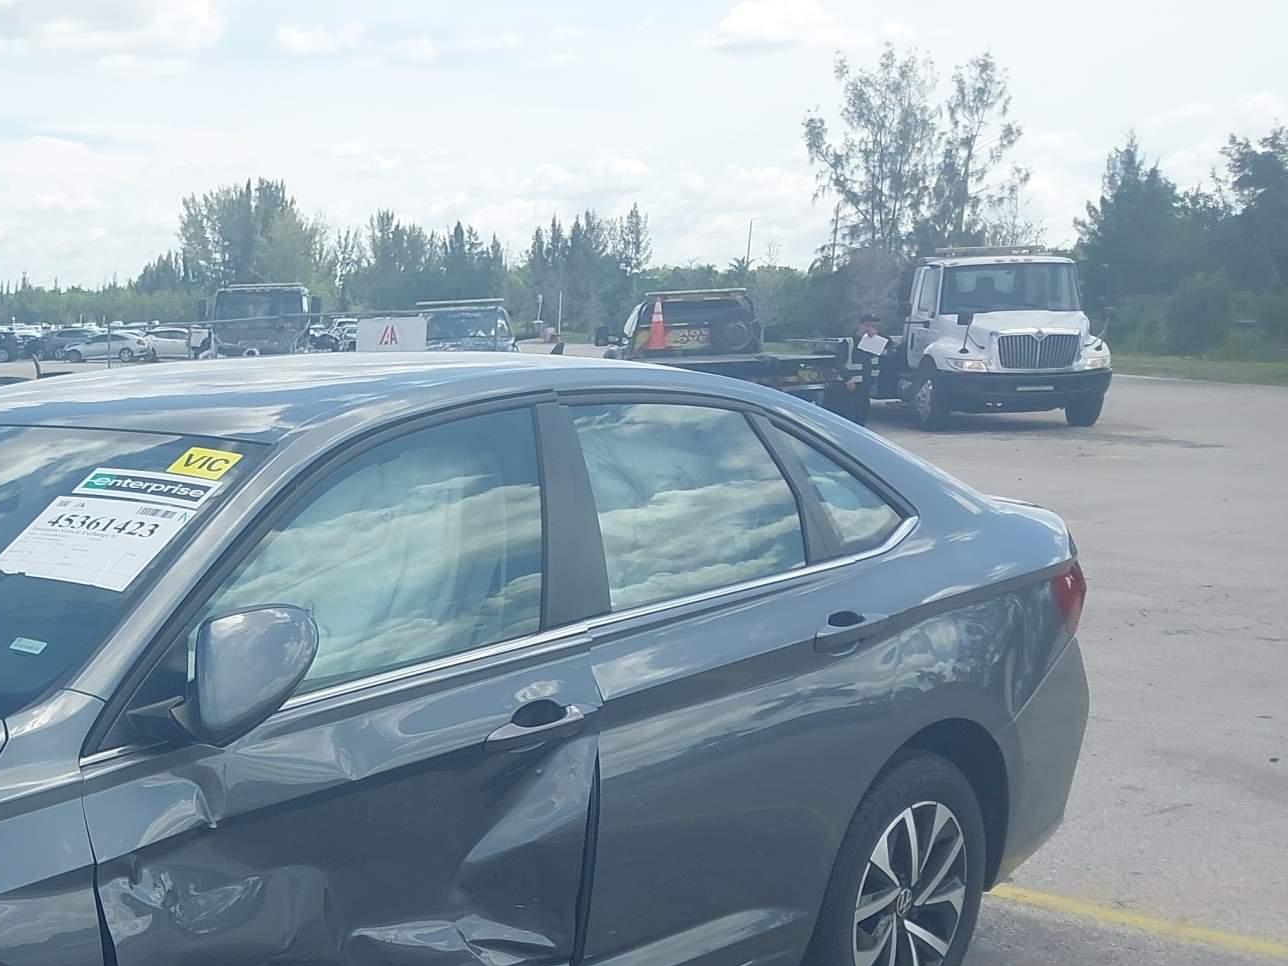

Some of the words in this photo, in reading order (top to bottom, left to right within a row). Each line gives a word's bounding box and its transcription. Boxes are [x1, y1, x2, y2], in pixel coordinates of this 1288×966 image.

[183, 453, 230, 472] VIC
[89, 476, 205, 498] enterprise
[47, 513, 161, 538] 45361423
